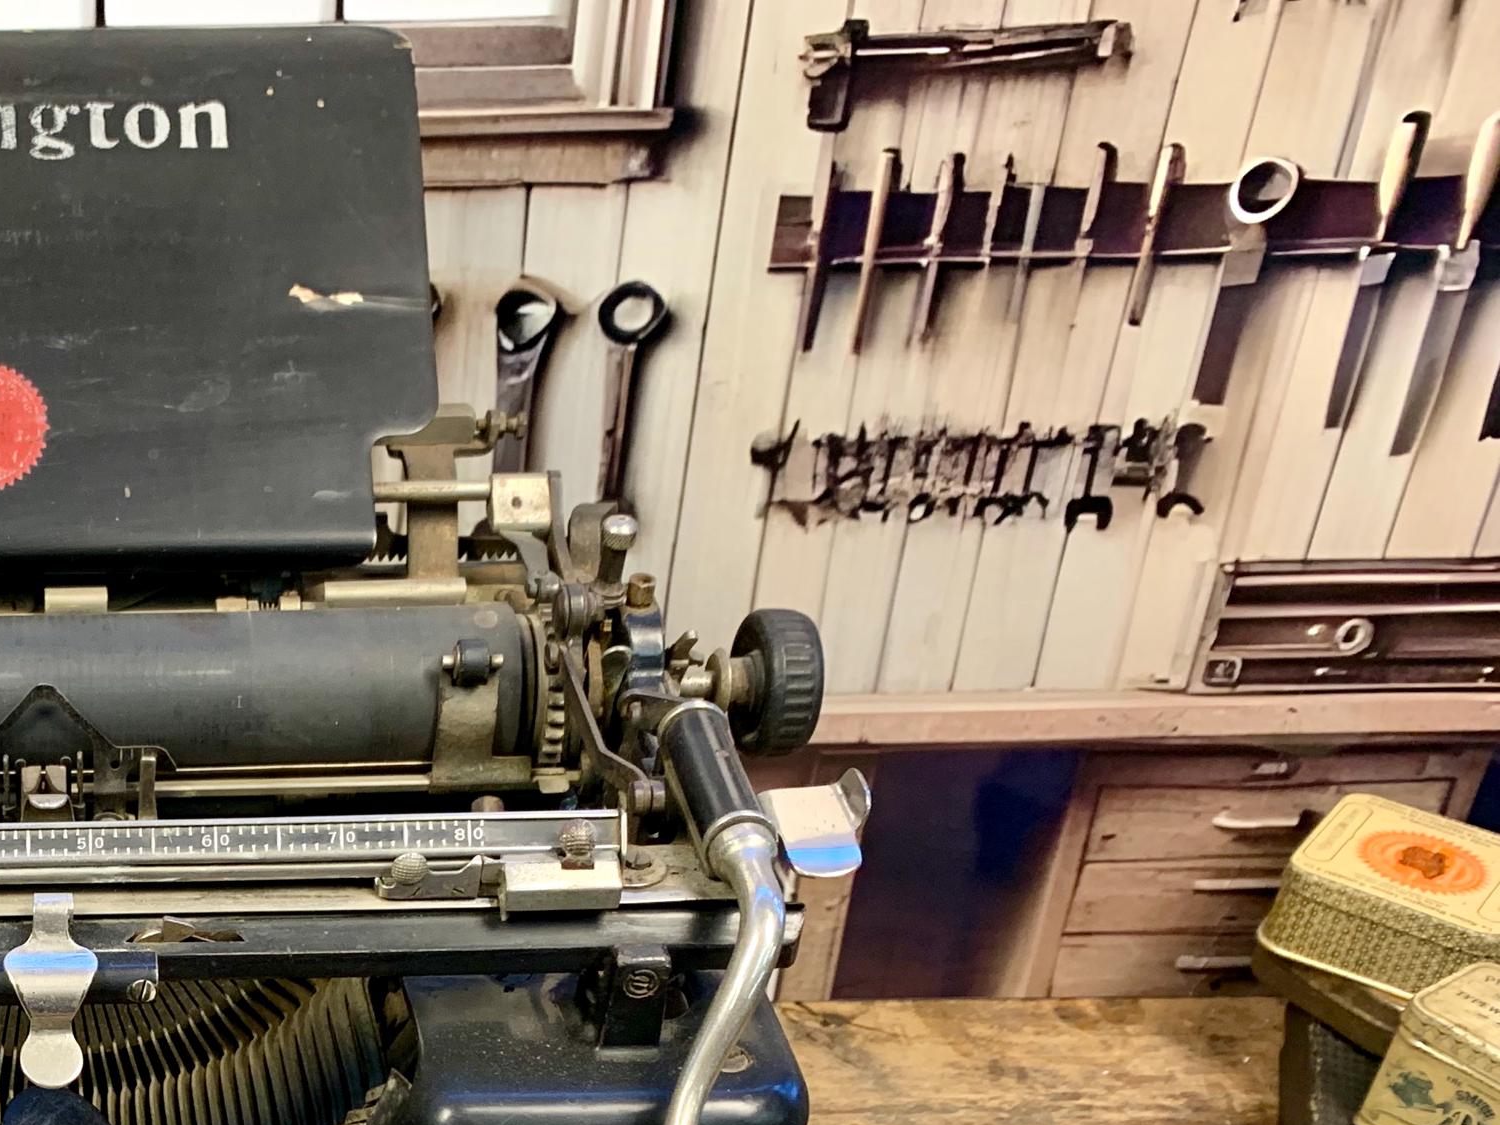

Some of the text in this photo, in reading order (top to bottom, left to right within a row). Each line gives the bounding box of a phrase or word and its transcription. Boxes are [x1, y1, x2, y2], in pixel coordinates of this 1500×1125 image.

[76, 836, 105, 850] 50
[201, 834, 230, 848] 60
[328, 831, 357, 845] 70
[454, 828, 485, 841] 80
